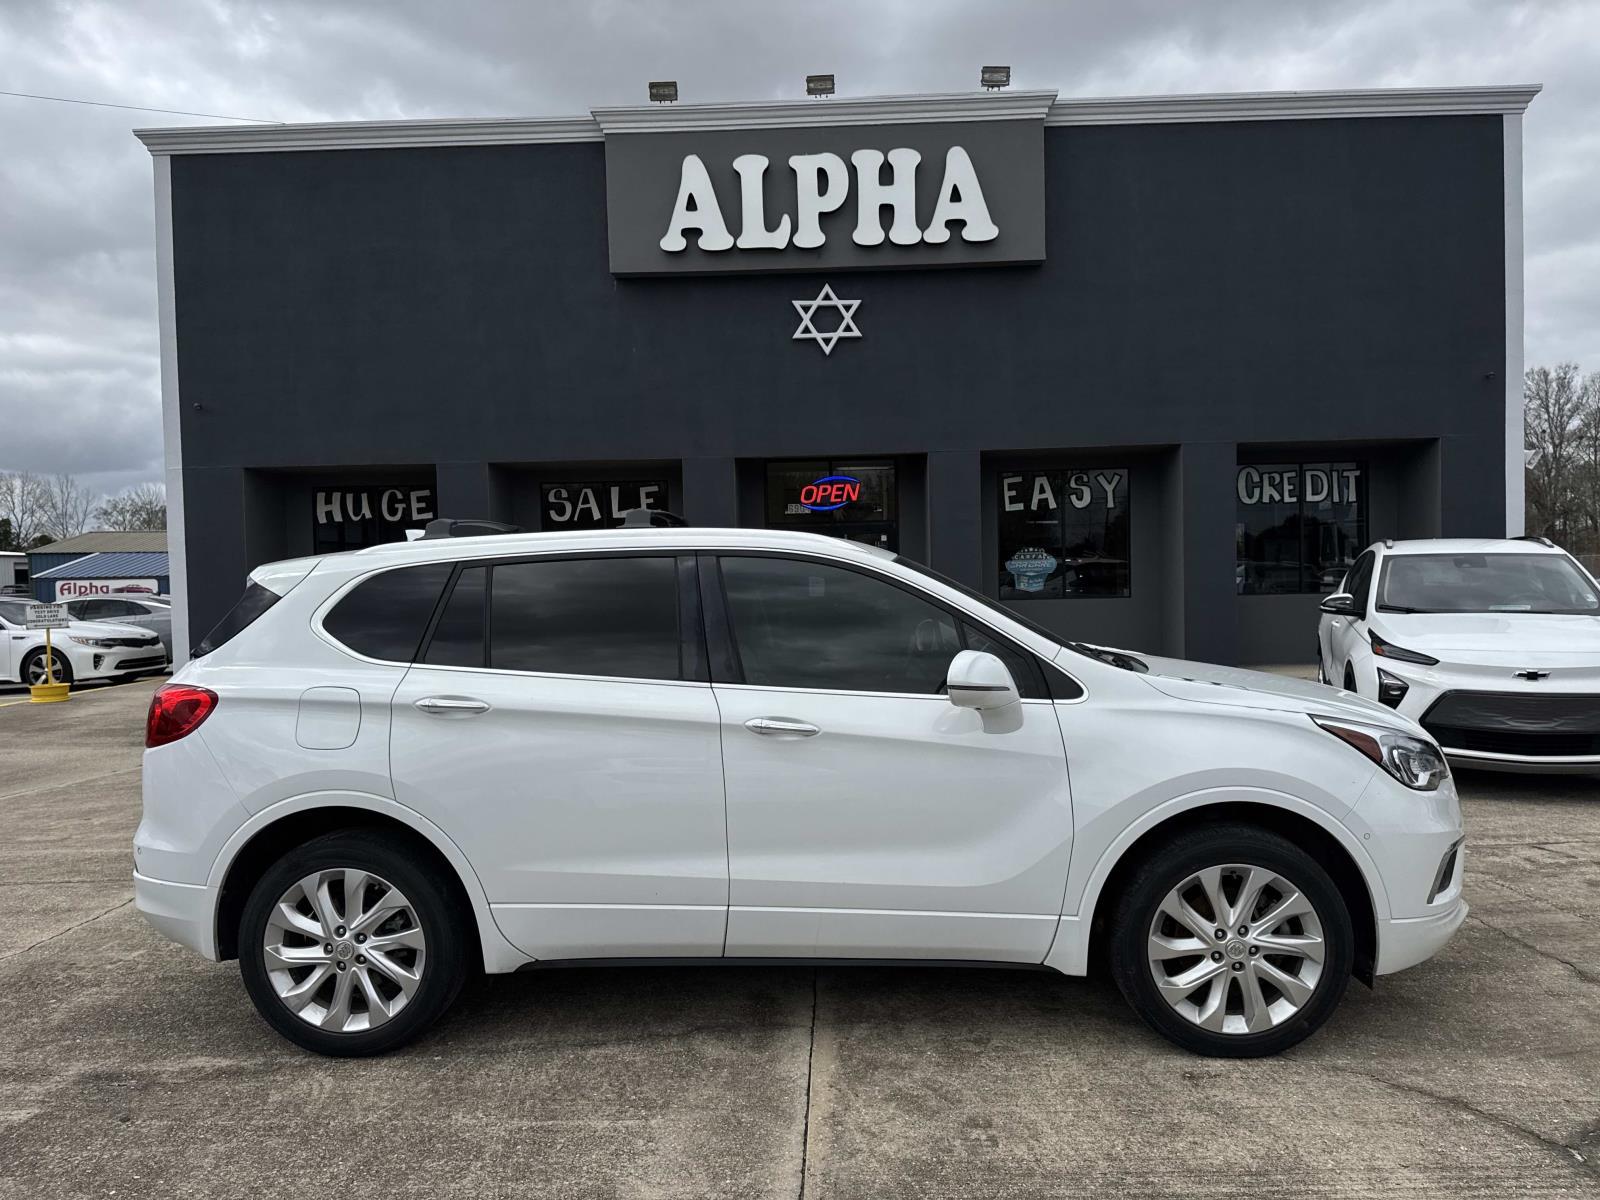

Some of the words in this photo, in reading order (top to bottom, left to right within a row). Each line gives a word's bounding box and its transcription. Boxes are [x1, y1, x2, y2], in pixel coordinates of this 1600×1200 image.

[660, 145, 1000, 252] ALPHA
[315, 489, 433, 524] HUGE
[546, 485, 660, 522] SALE
[800, 482, 861, 504] OPEN
[1003, 472, 1121, 511] EASY
[1237, 466, 1361, 504] CREDIT
[59, 582, 110, 597] Alpha
